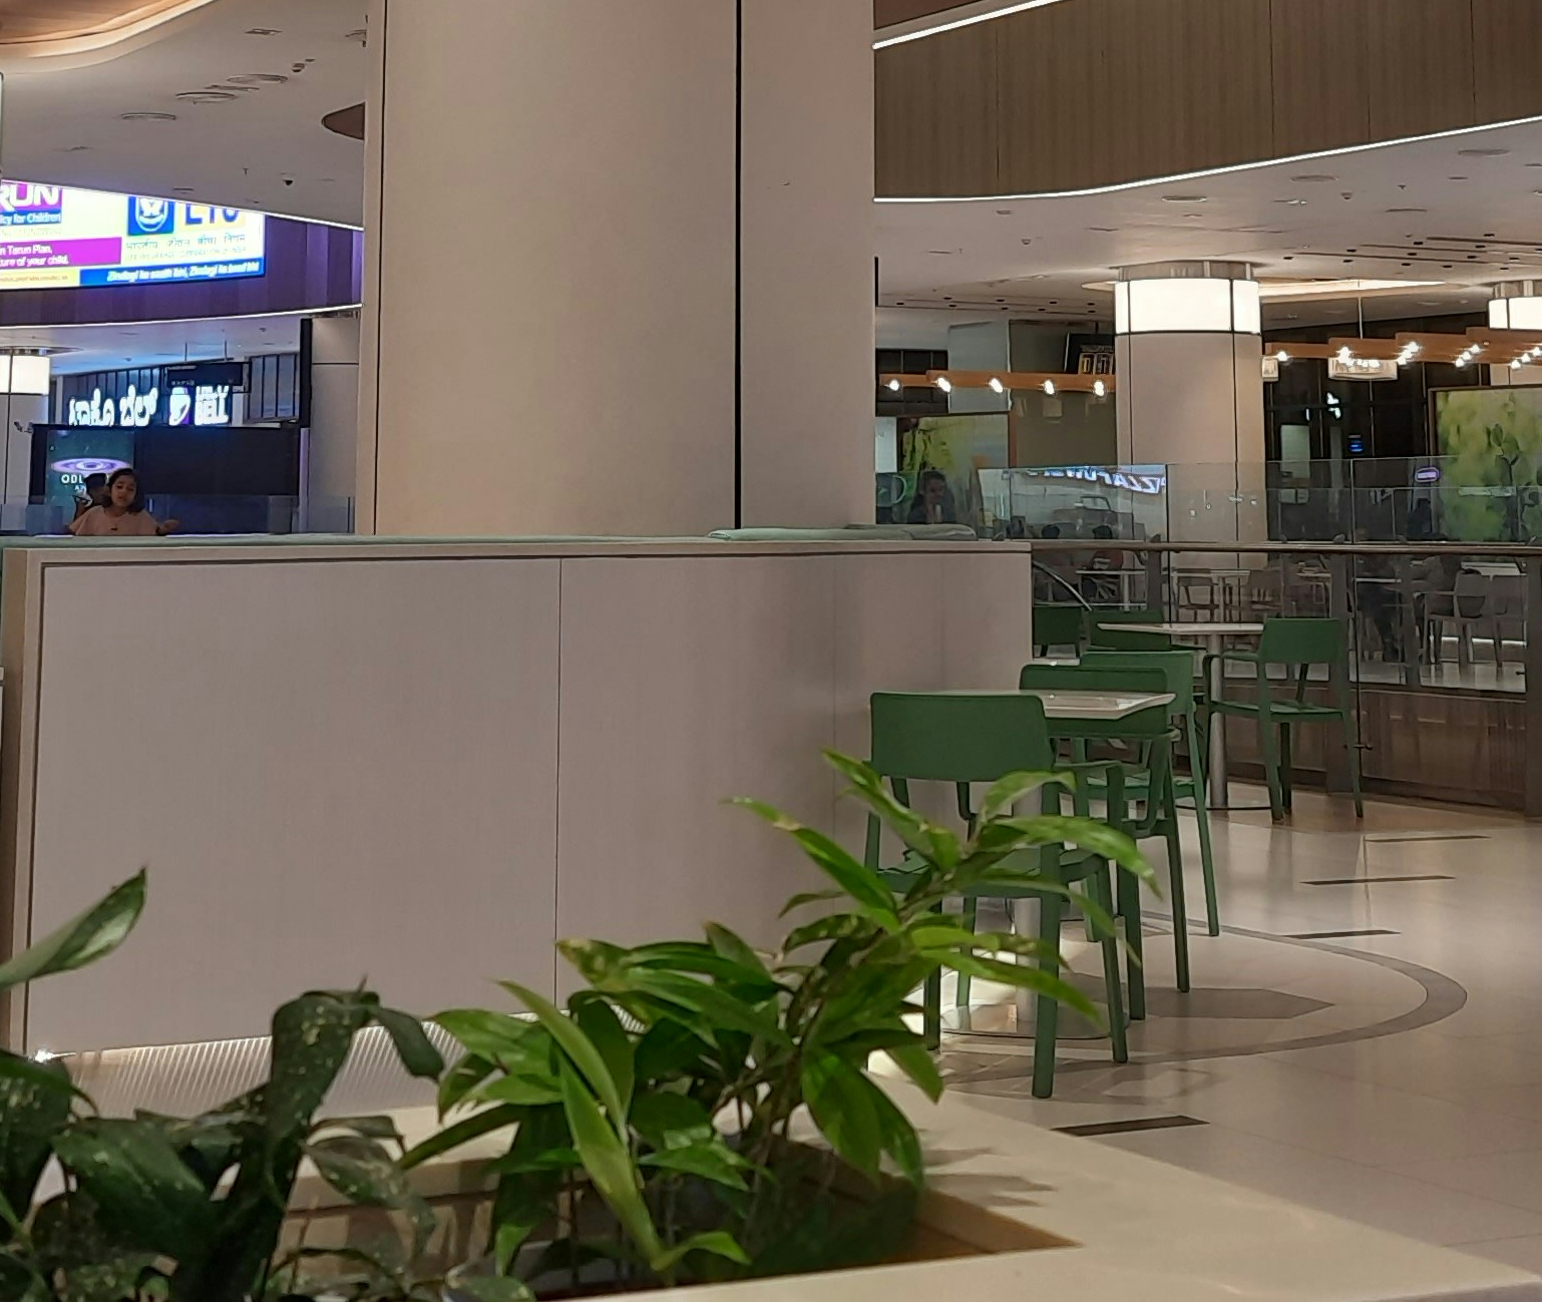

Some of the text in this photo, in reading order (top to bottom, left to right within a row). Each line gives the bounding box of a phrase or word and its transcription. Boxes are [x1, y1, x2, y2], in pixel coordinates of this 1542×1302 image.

[14, 213, 26, 224] for
[27, 212, 61, 224] Children
[7, 245, 32, 256] Tarun
